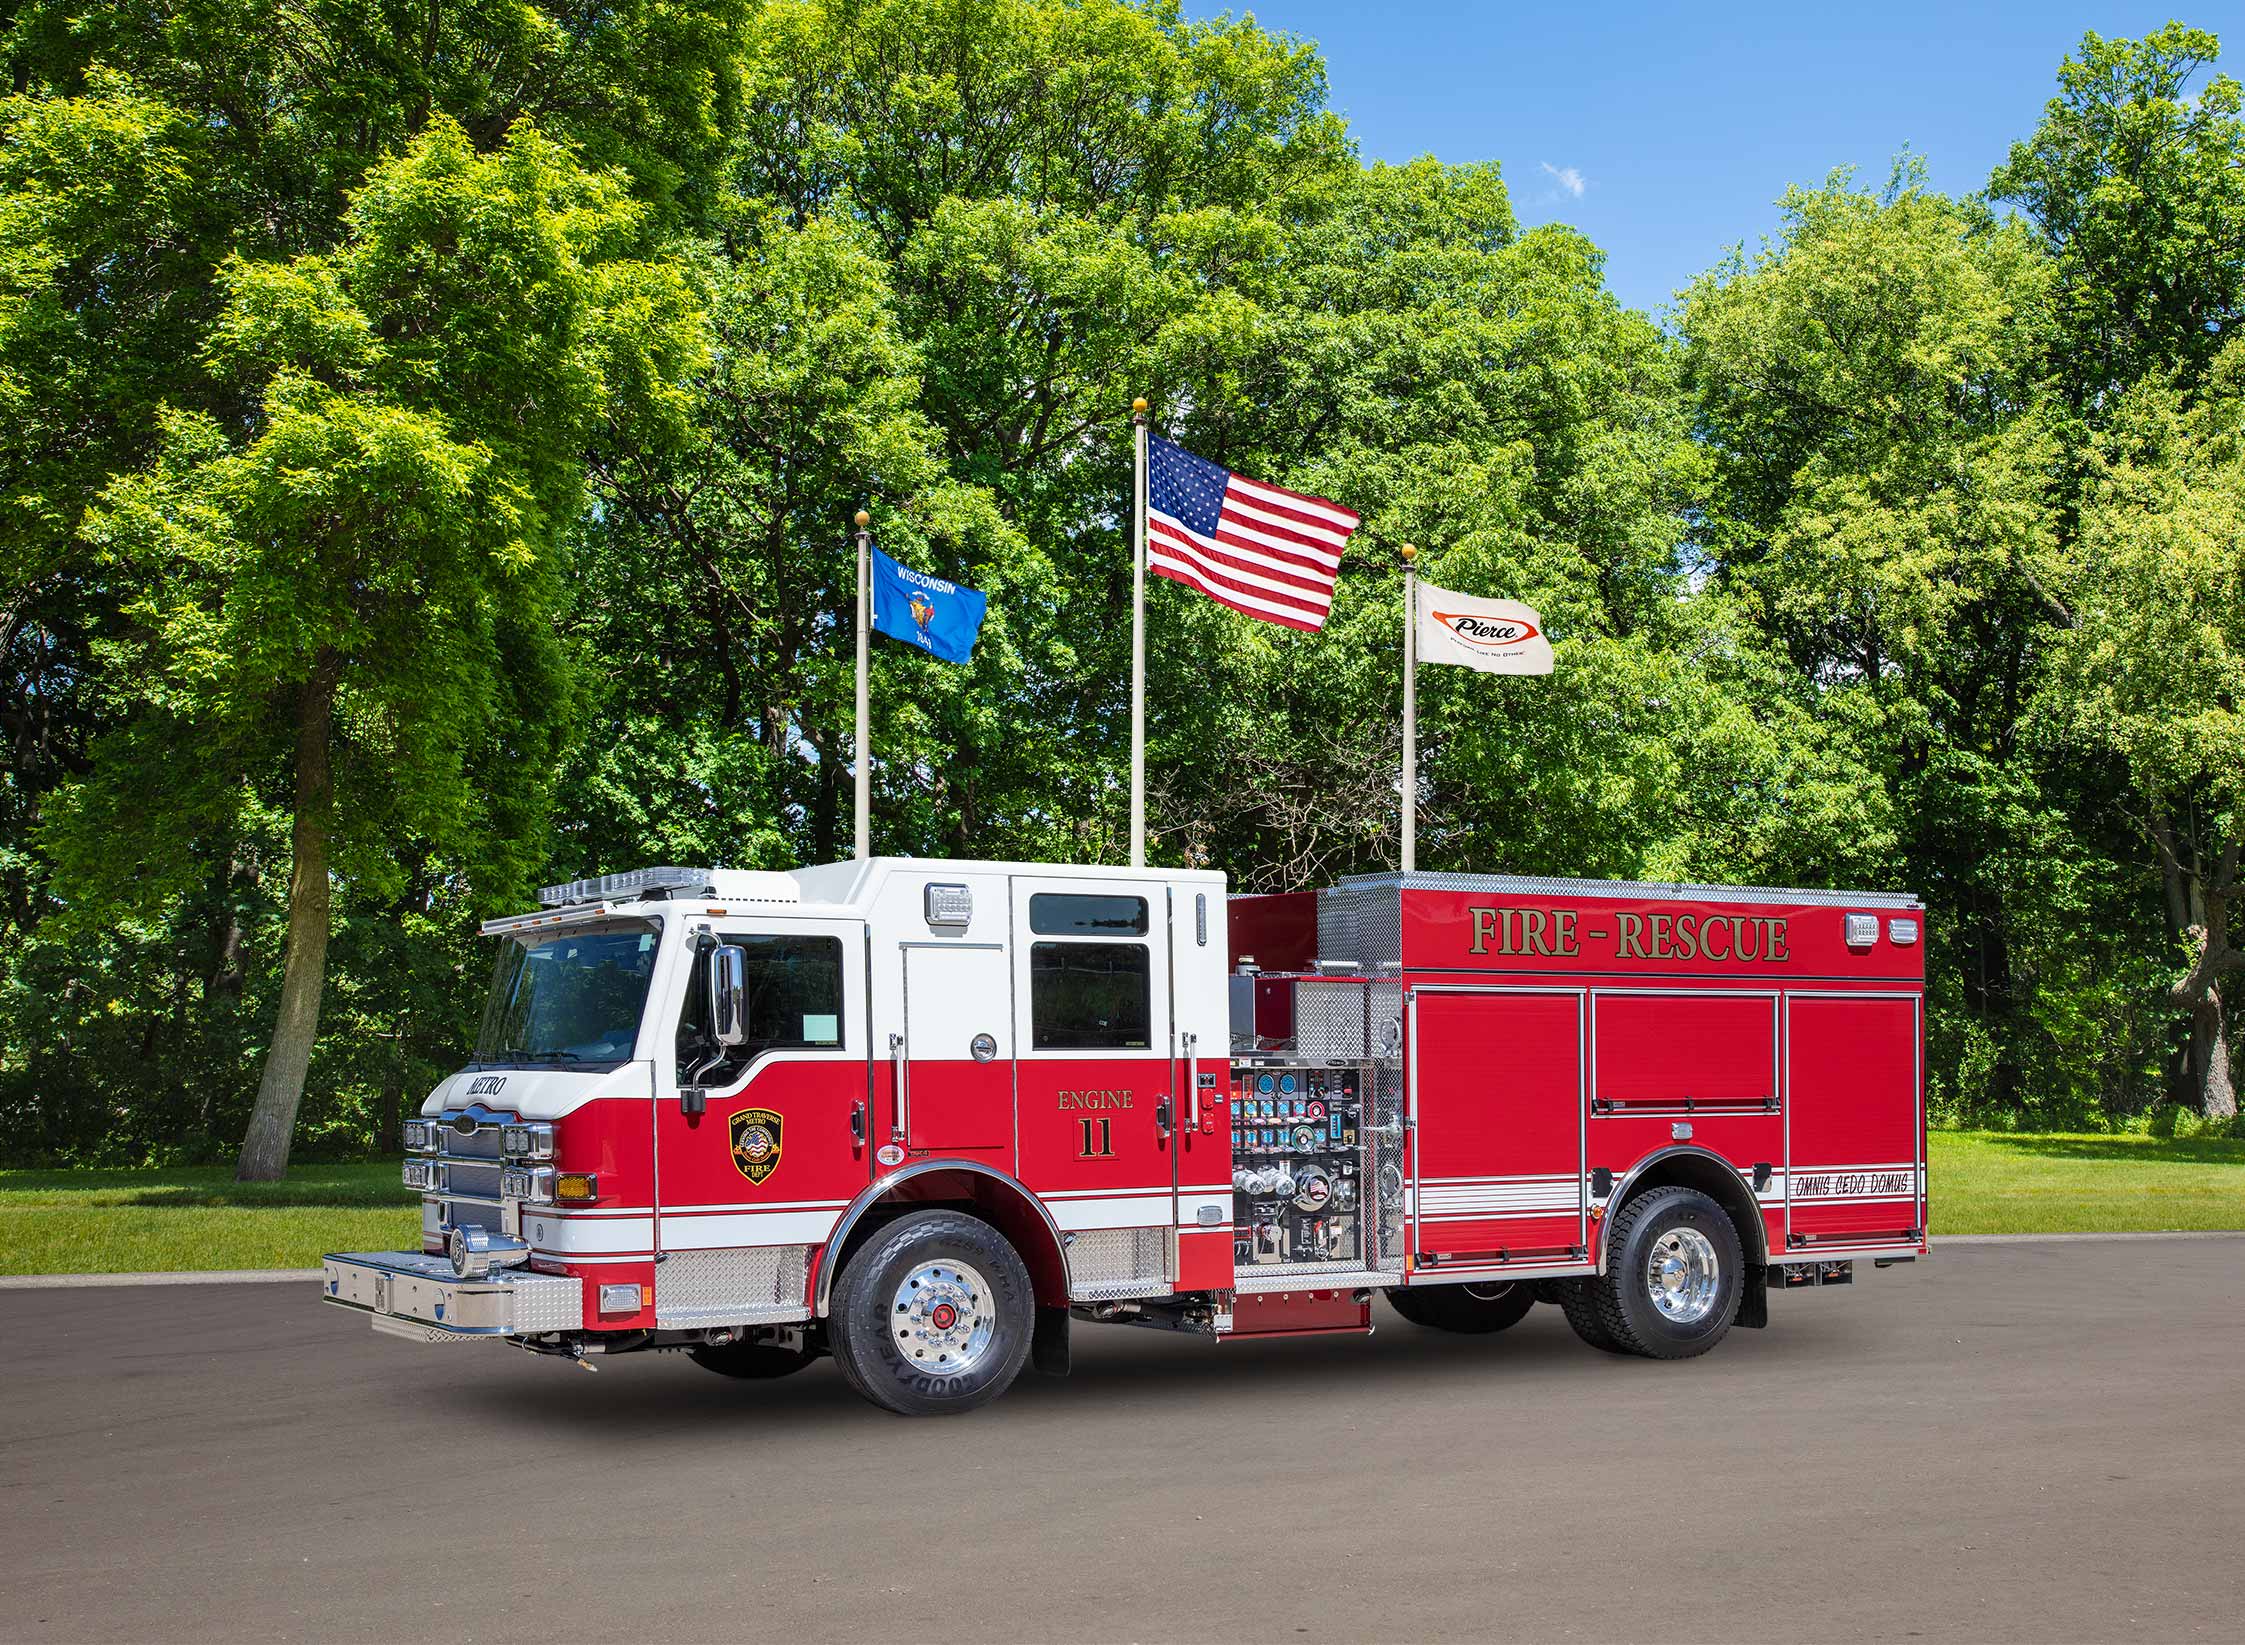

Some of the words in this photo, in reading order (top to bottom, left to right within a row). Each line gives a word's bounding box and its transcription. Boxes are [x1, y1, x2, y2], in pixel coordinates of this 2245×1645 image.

[897, 566, 956, 595] WISCONSIN
[1455, 618, 1516, 638] Pierce
[1468, 907, 1581, 958] FIRE
[1615, 912, 1791, 962] RESCUE
[466, 1076, 507, 1095] METRO
[1057, 1090, 1134, 1110] ENGINE
[731, 1112, 753, 1125] GRAND
[753, 1112, 780, 1125] TRAVERSE
[1078, 1117, 1115, 1157] 11
[1795, 1175, 1831, 1196] OMNIS
[1835, 1174, 1866, 1195] CEDO
[1870, 1173, 1908, 1193] DOMUS
